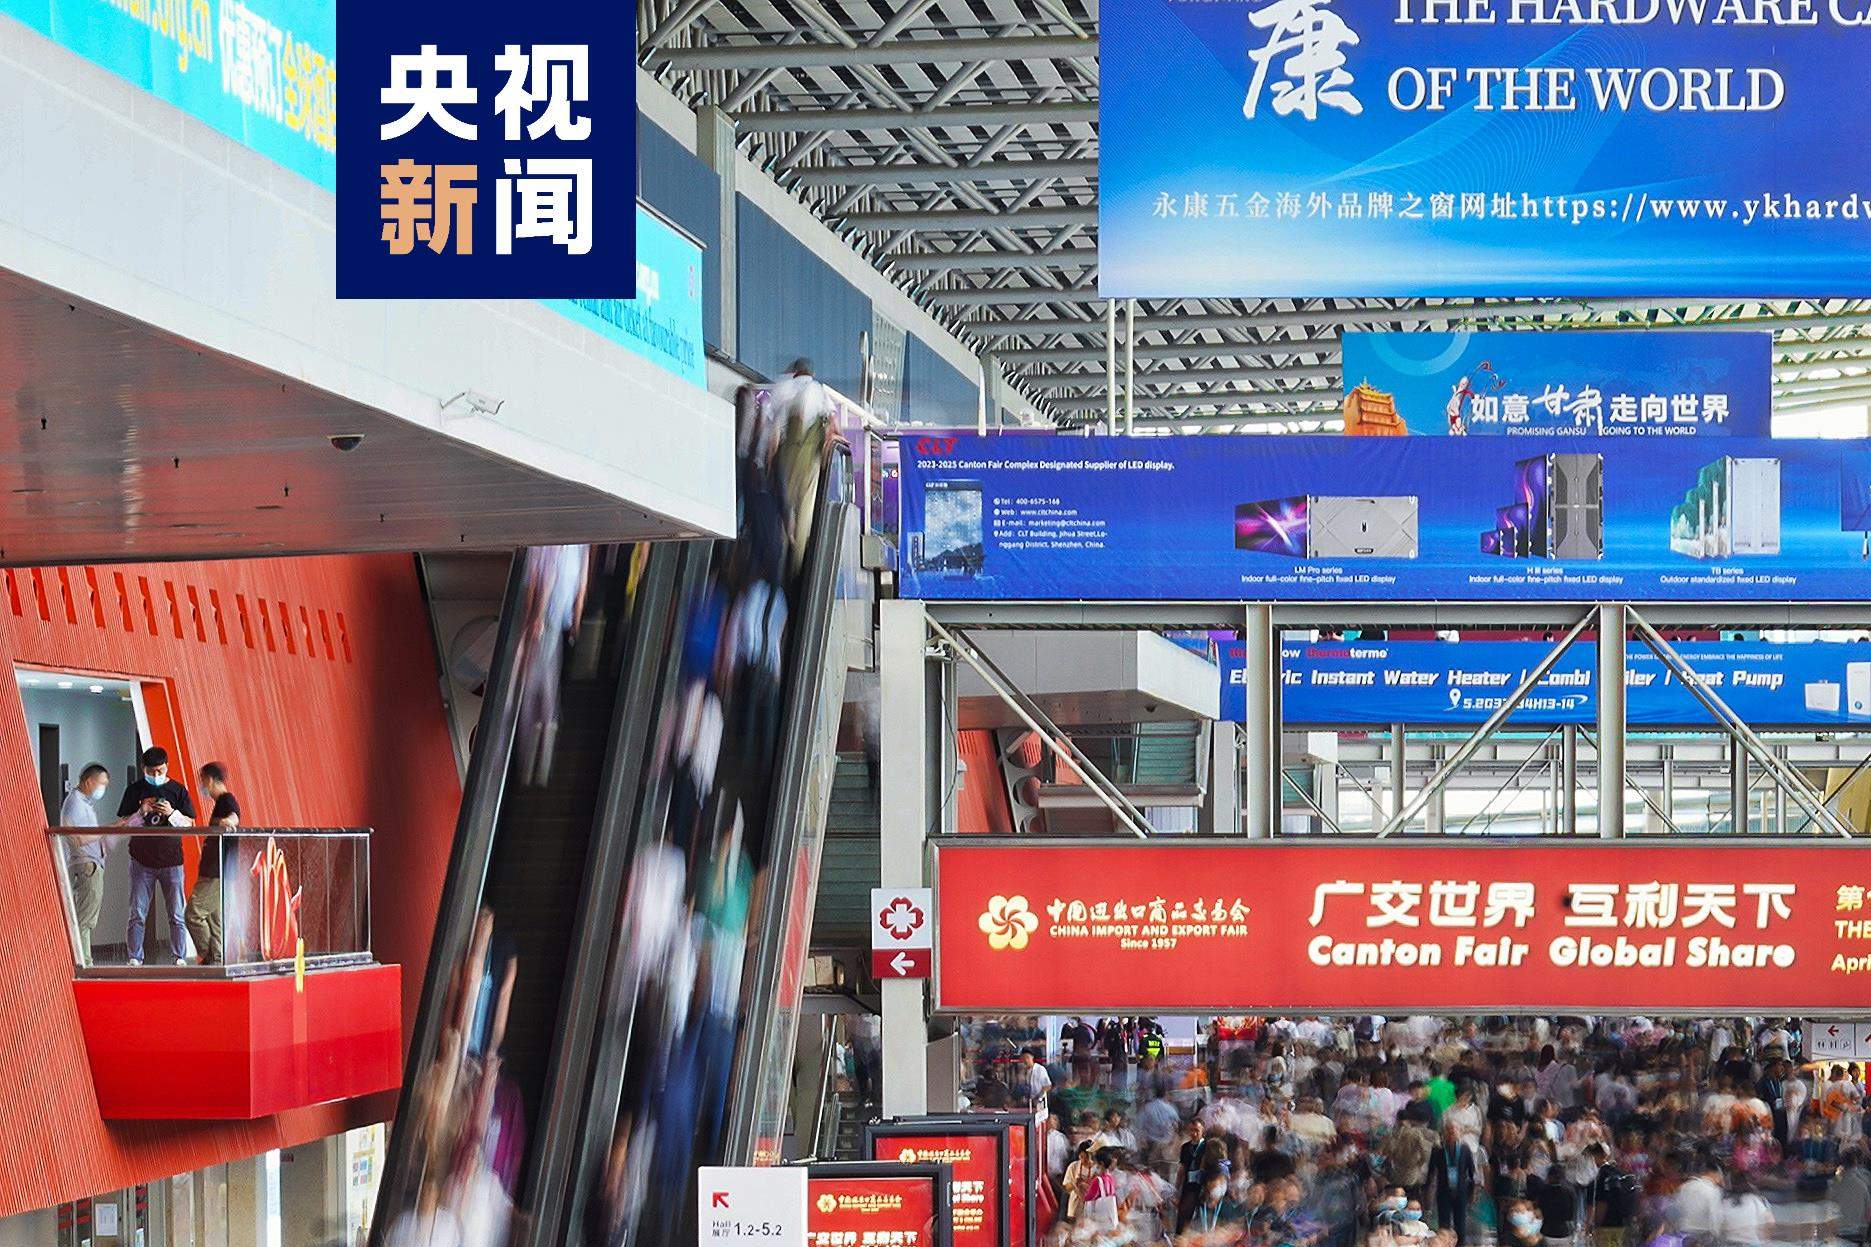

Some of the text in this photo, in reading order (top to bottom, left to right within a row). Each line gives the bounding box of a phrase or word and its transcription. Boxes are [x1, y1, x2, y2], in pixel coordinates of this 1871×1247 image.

[1394, 0, 1496, 24] THE
[1506, 0, 1818, 26] HARDWARE
[1387, 66, 1785, 112] OF THE WORLD
[1506, 426, 1587, 436] PROMISING GANSU
[1602, 426, 1697, 436] GOING TO THE WORLD
[917, 459, 1175, 472] 2023-2025 Canton Fair Complex Designated Supplier of LED display.
[1310, 669, 1376, 686] Instant
[1383, 669, 1440, 686] Water
[1447, 669, 1512, 686] Heater
[1732, 670, 1785, 691] Pump
[1308, 879, 1797, 929] 广交世界 互利天下
[1049, 924, 1248, 938] CHINA IMPORT AND EXPORT FAIR
[1120, 937, 1178, 950] Since 1957
[1307, 935, 1796, 968] Canton Fair Global Share
[712, 1221, 783, 1237] Hall 1.2-5.2
